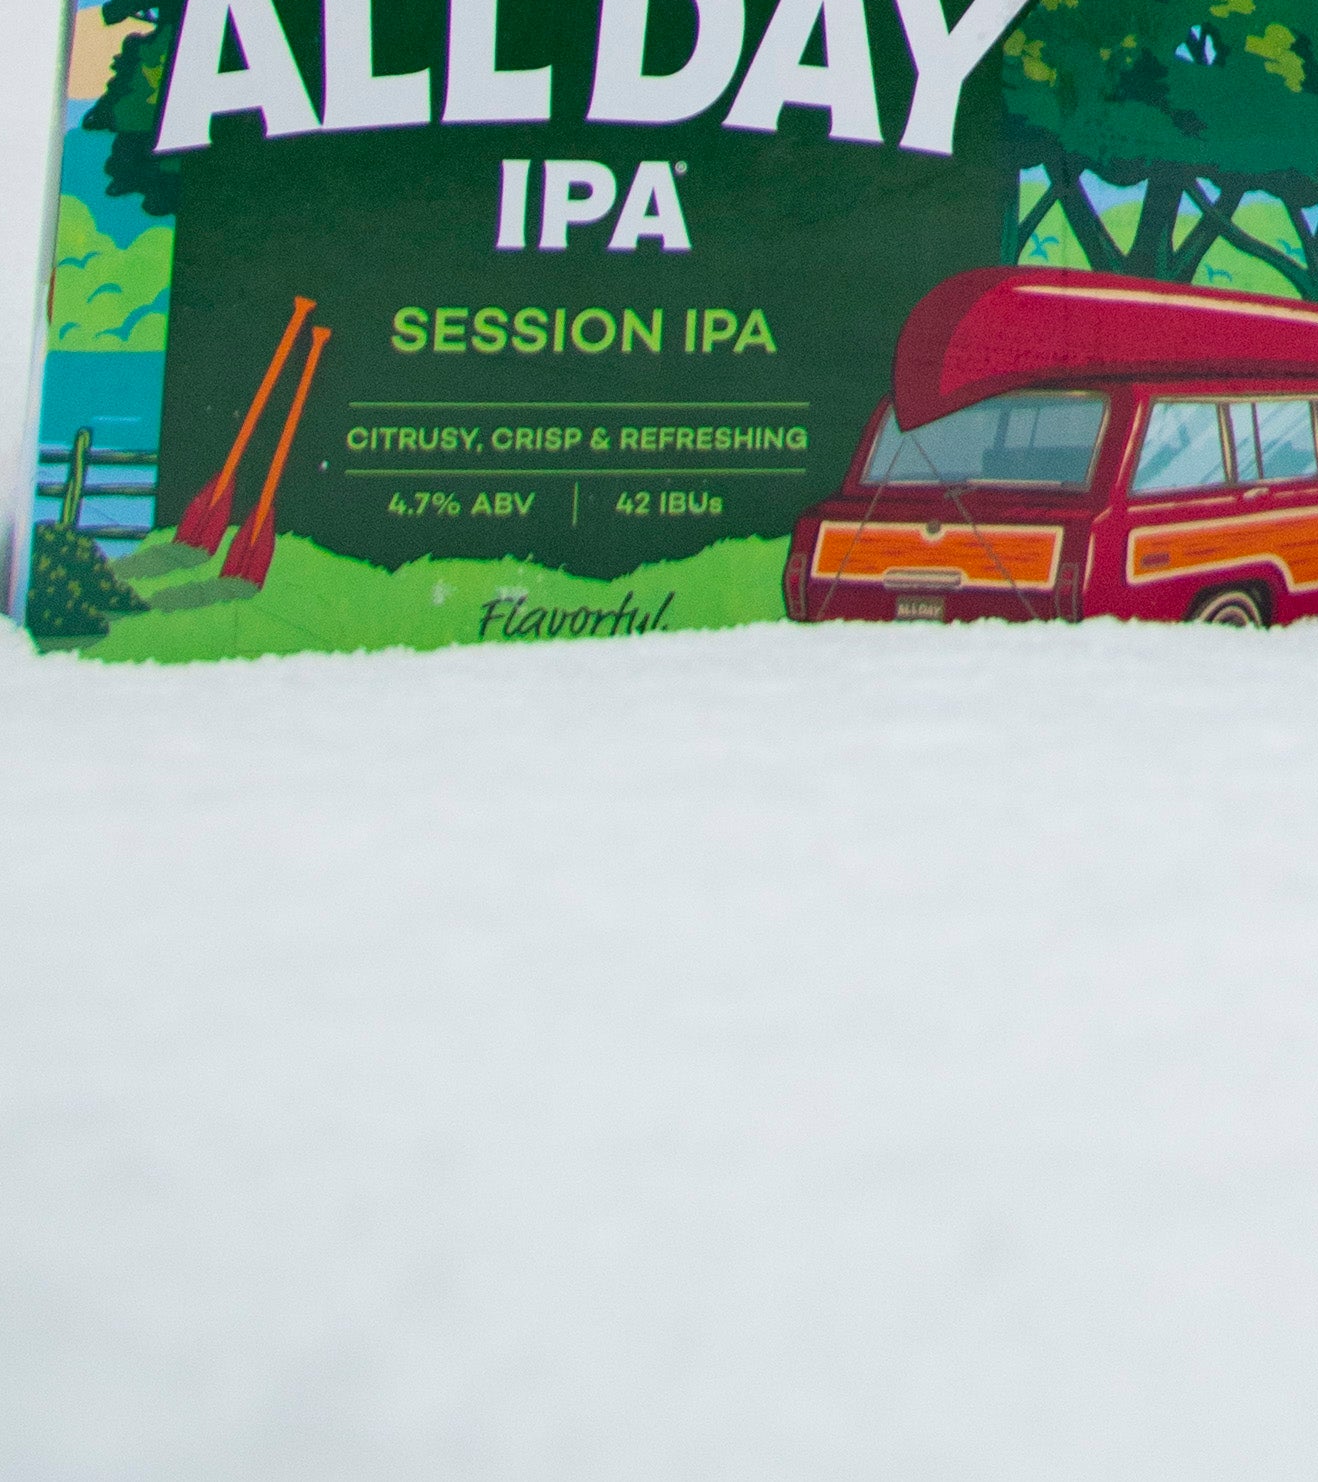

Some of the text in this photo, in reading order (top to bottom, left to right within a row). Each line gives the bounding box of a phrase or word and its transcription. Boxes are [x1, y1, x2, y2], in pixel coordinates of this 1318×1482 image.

[495, 159, 693, 251] IPA
[390, 305, 778, 354] SESSION IPA
[346, 425, 809, 453] CITRUSY, CRISP & REFRESHING
[388, 491, 536, 516] 4.7% ABV
[614, 491, 724, 515] 42 IBUs
